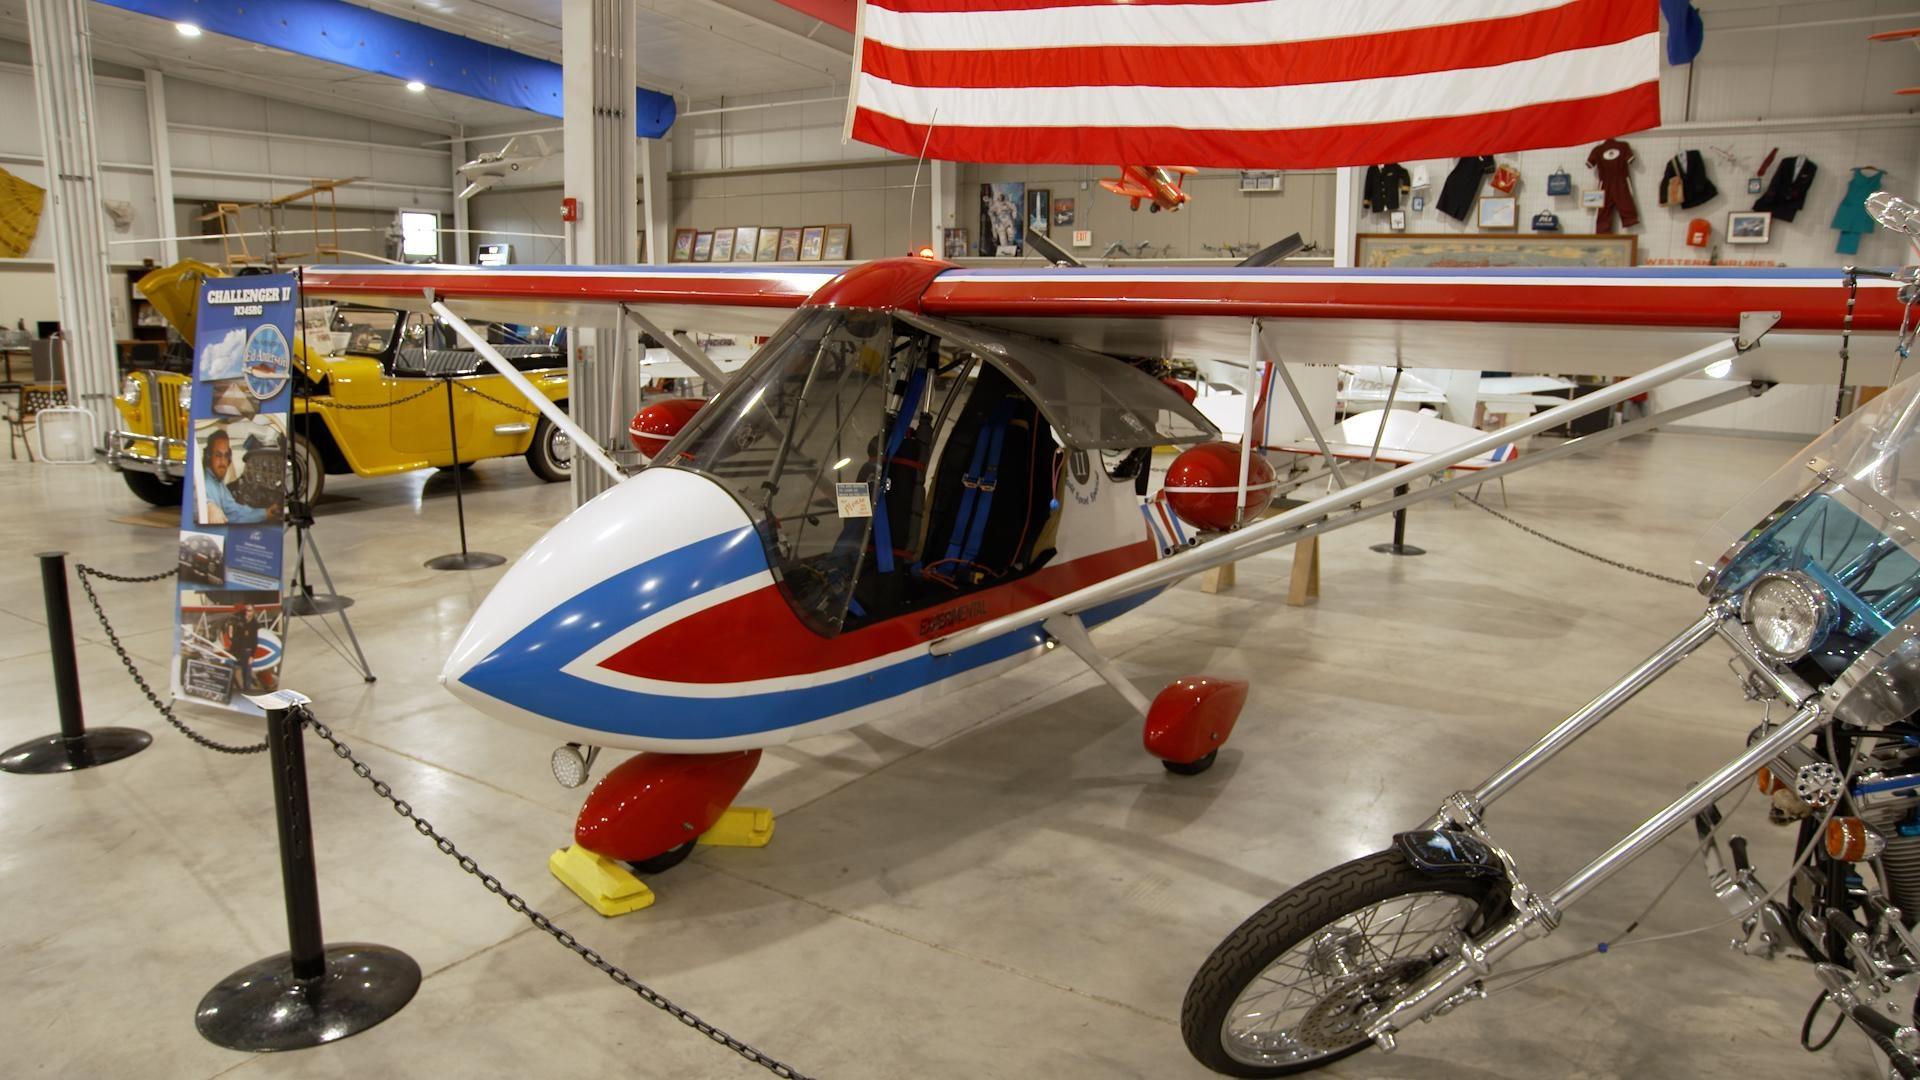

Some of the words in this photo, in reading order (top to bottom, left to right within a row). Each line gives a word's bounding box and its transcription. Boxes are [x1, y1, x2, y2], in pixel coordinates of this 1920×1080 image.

[1076, 231, 1088, 241] EXIT
[207, 288, 280, 304] CHALLENGER
[919, 600, 987, 636] EXPERIMENTAL
